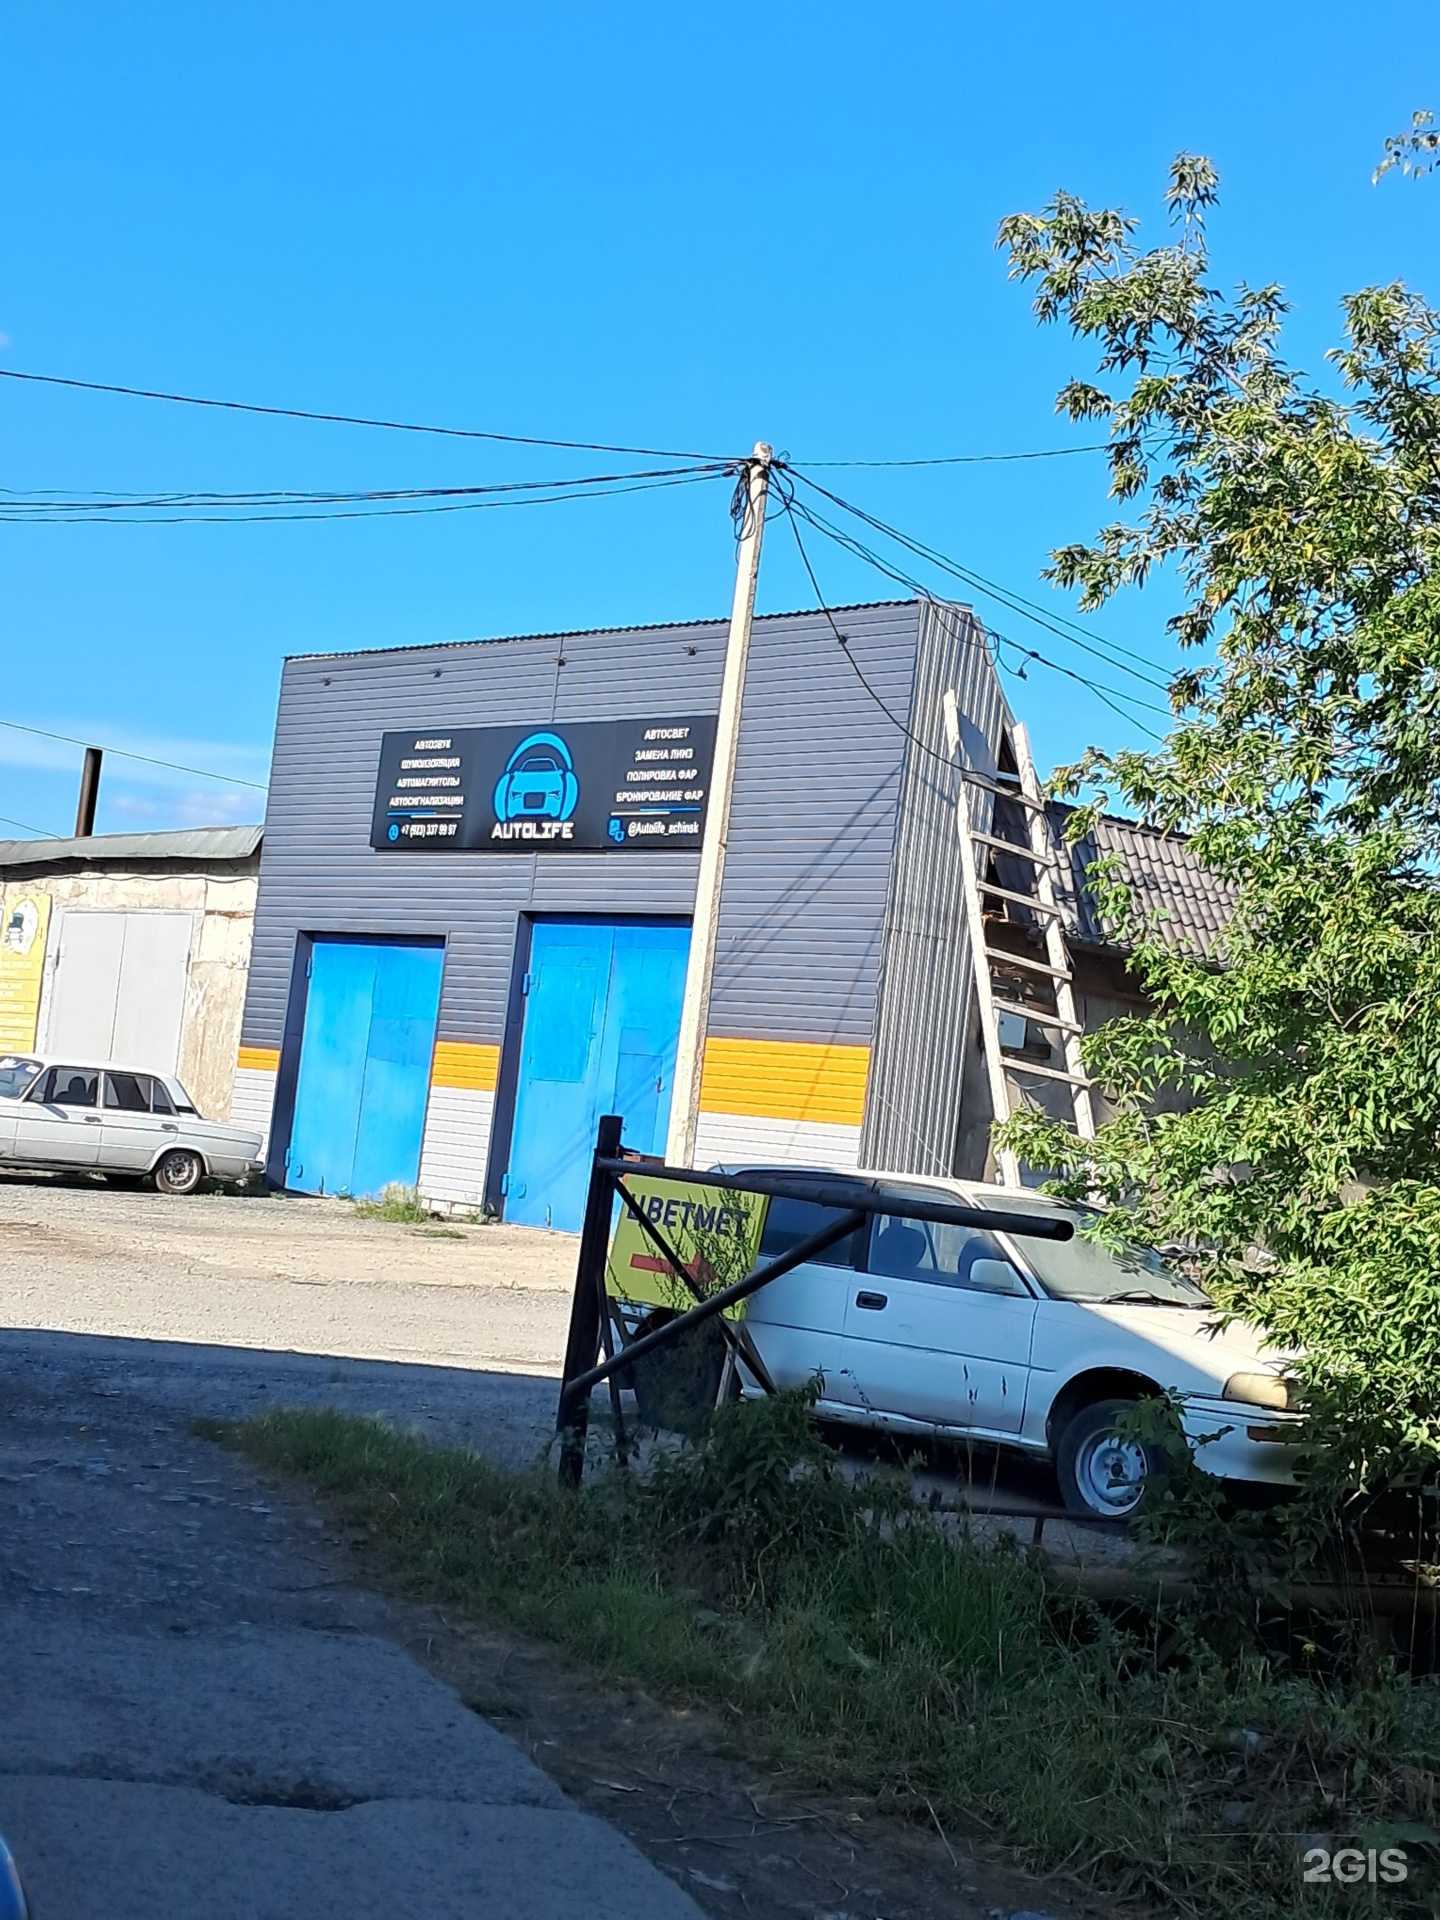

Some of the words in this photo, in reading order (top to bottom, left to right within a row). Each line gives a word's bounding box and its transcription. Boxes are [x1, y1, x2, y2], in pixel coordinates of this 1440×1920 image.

[644, 727, 690, 740] АВТОСВЕТ
[634, 750, 669, 761] ЗАМЕНА
[626, 771, 677, 782] ПОЛИРОВКА
[678, 769, 698, 780] ФАР
[616, 791, 683, 803] БРОНИРОВАНИЕ
[684, 790, 704, 801] ФАР
[491, 822, 575, 839] AUTOLIFE
